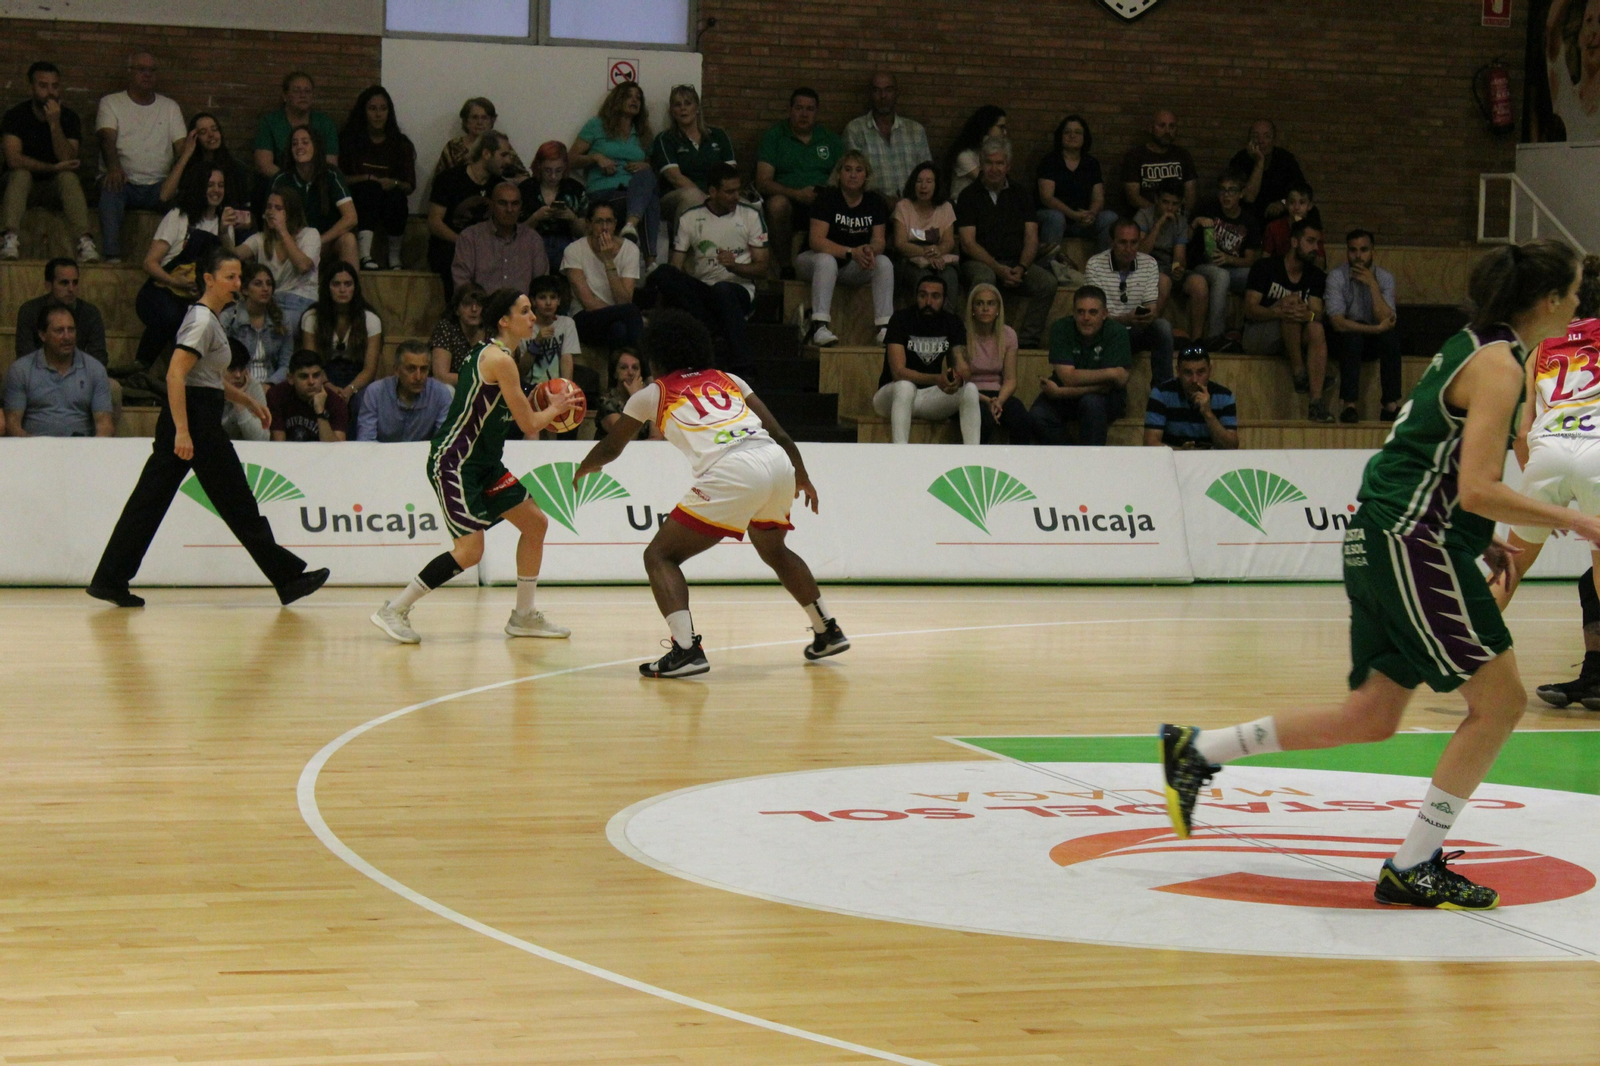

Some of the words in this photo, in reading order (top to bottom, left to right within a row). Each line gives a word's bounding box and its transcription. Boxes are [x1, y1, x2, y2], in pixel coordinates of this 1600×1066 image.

[1546, 345, 1600, 402] 23
[680, 381, 732, 420] 10
[300, 503, 439, 539] Unicaja
[1033, 504, 1156, 539] Unicaja
[758, 807, 976, 822] SOL
